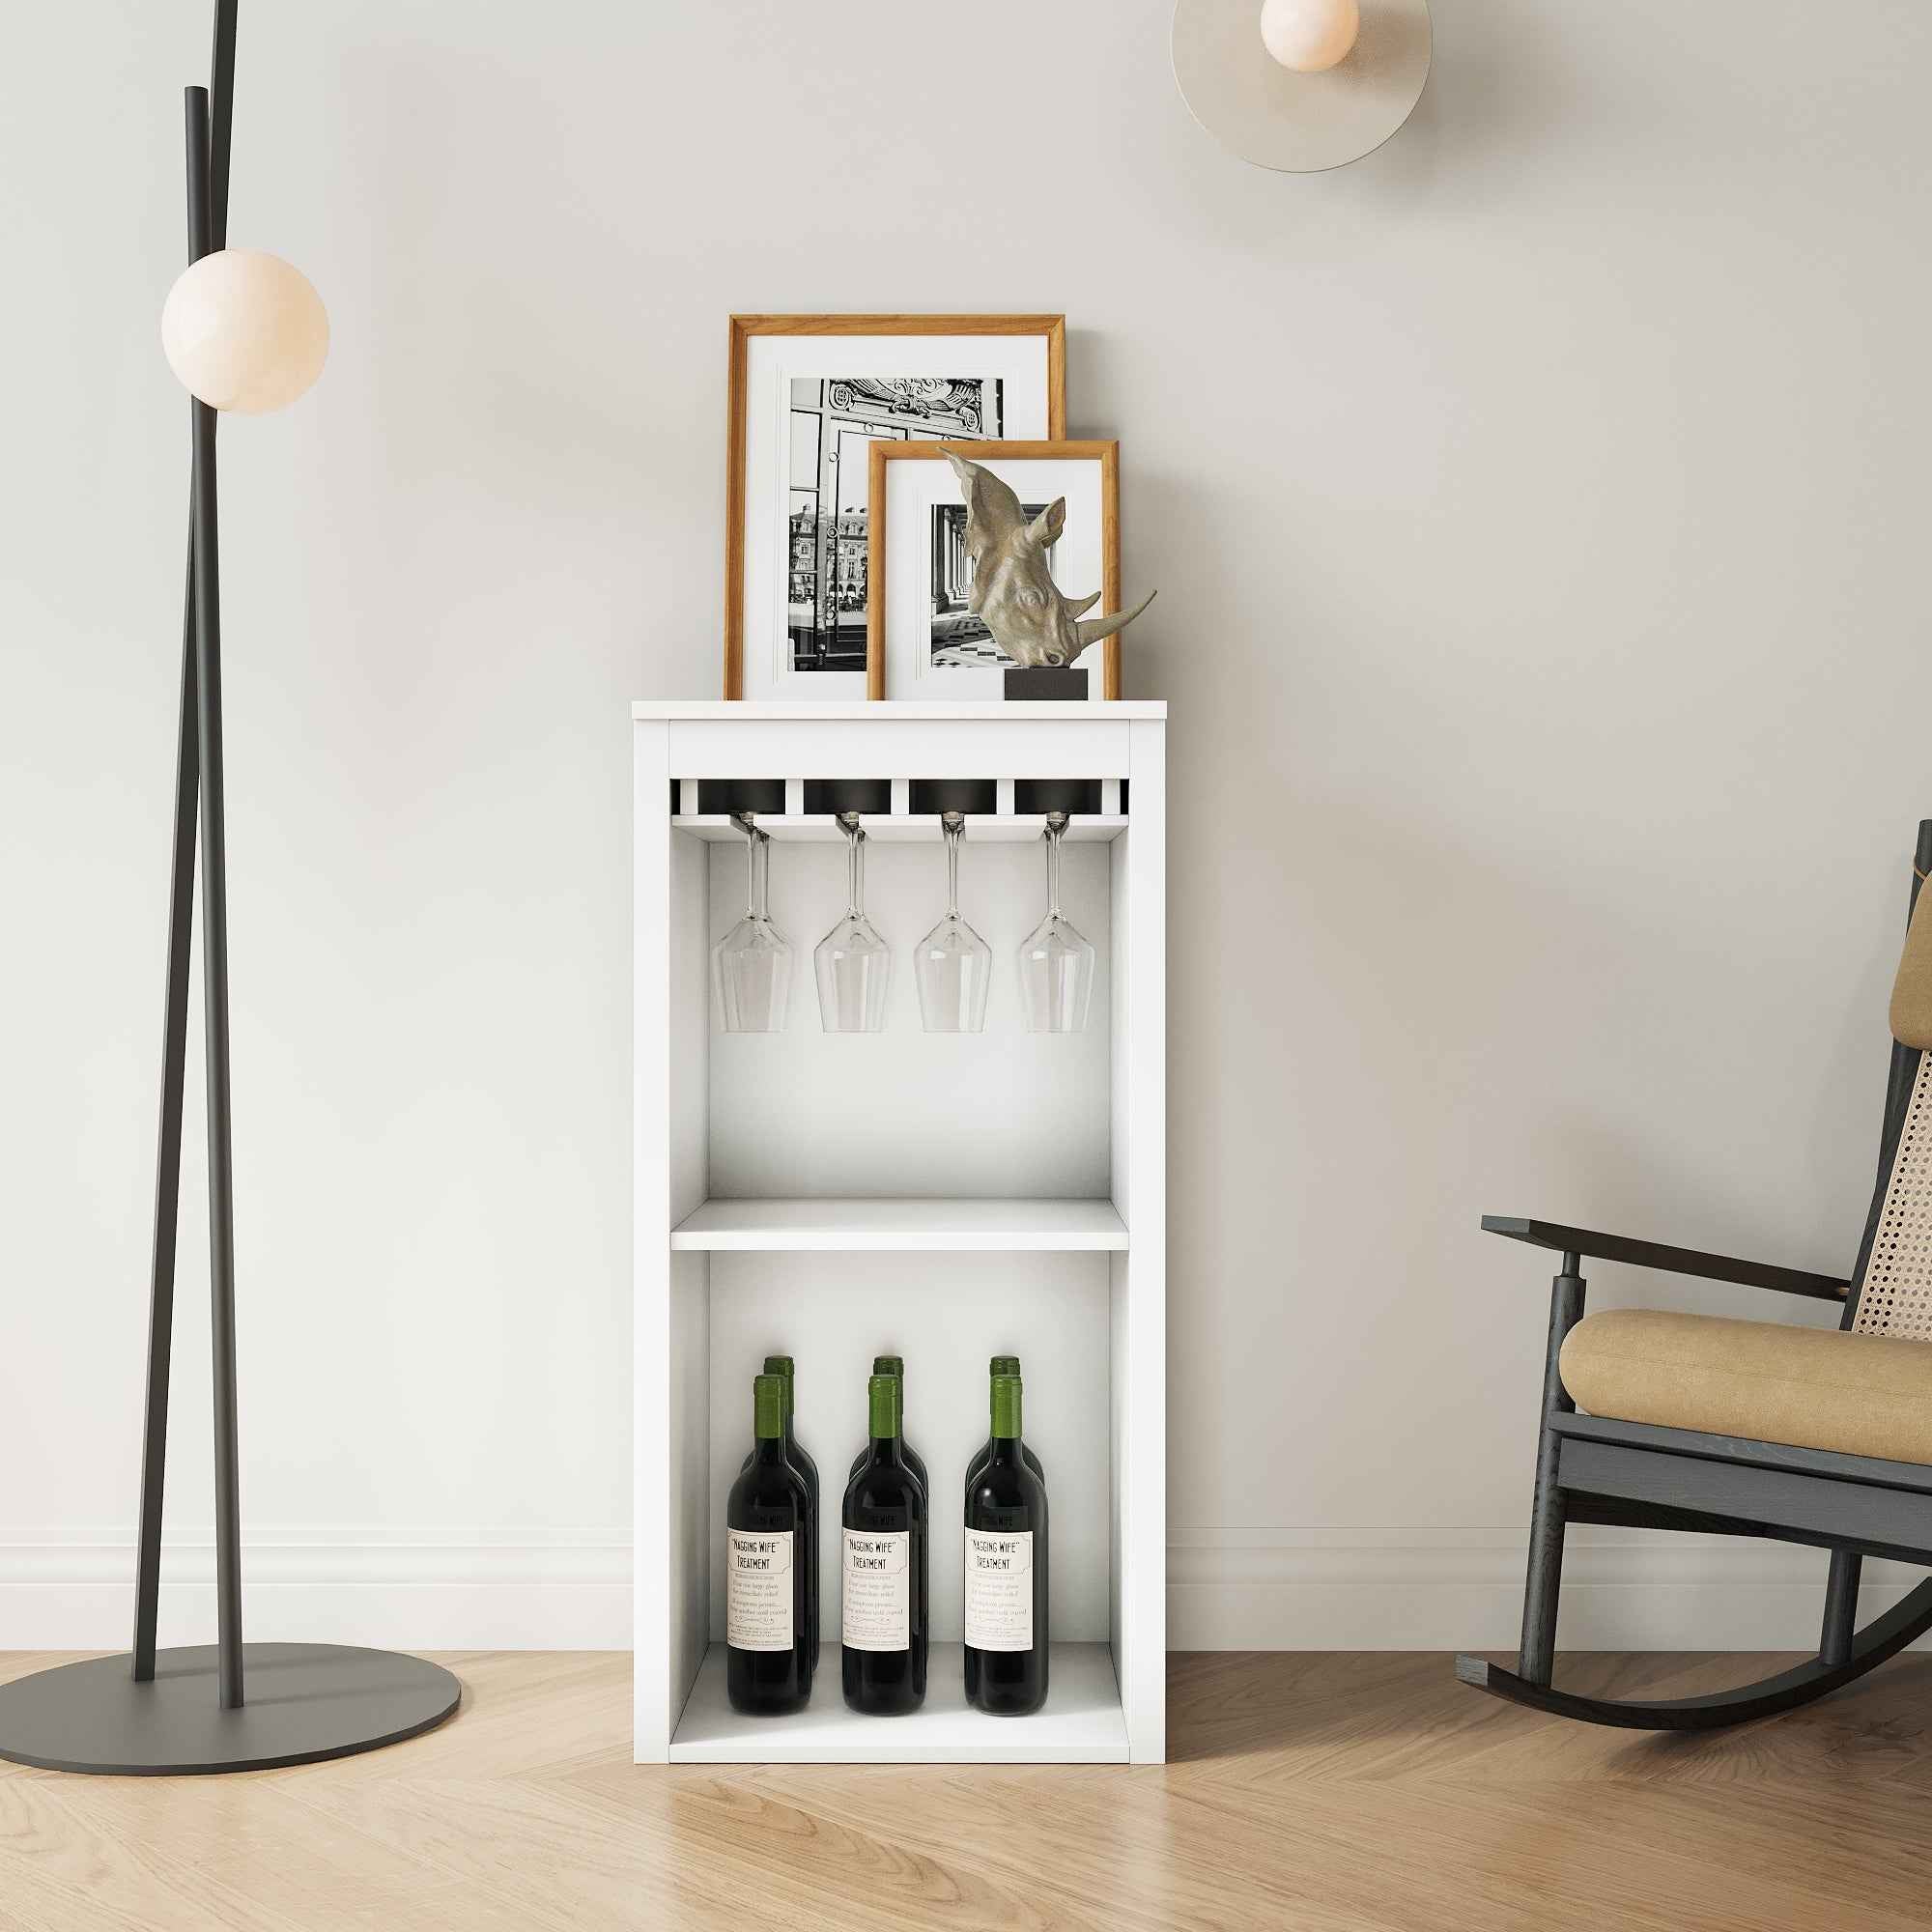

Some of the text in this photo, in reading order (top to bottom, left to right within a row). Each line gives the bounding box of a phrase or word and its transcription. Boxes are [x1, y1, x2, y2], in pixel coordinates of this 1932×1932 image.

[737, 1555, 770, 1570] TREATMENT
[853, 1555, 887, 1570] TREATMENT
[976, 1555, 1010, 1570] TREATMENT
